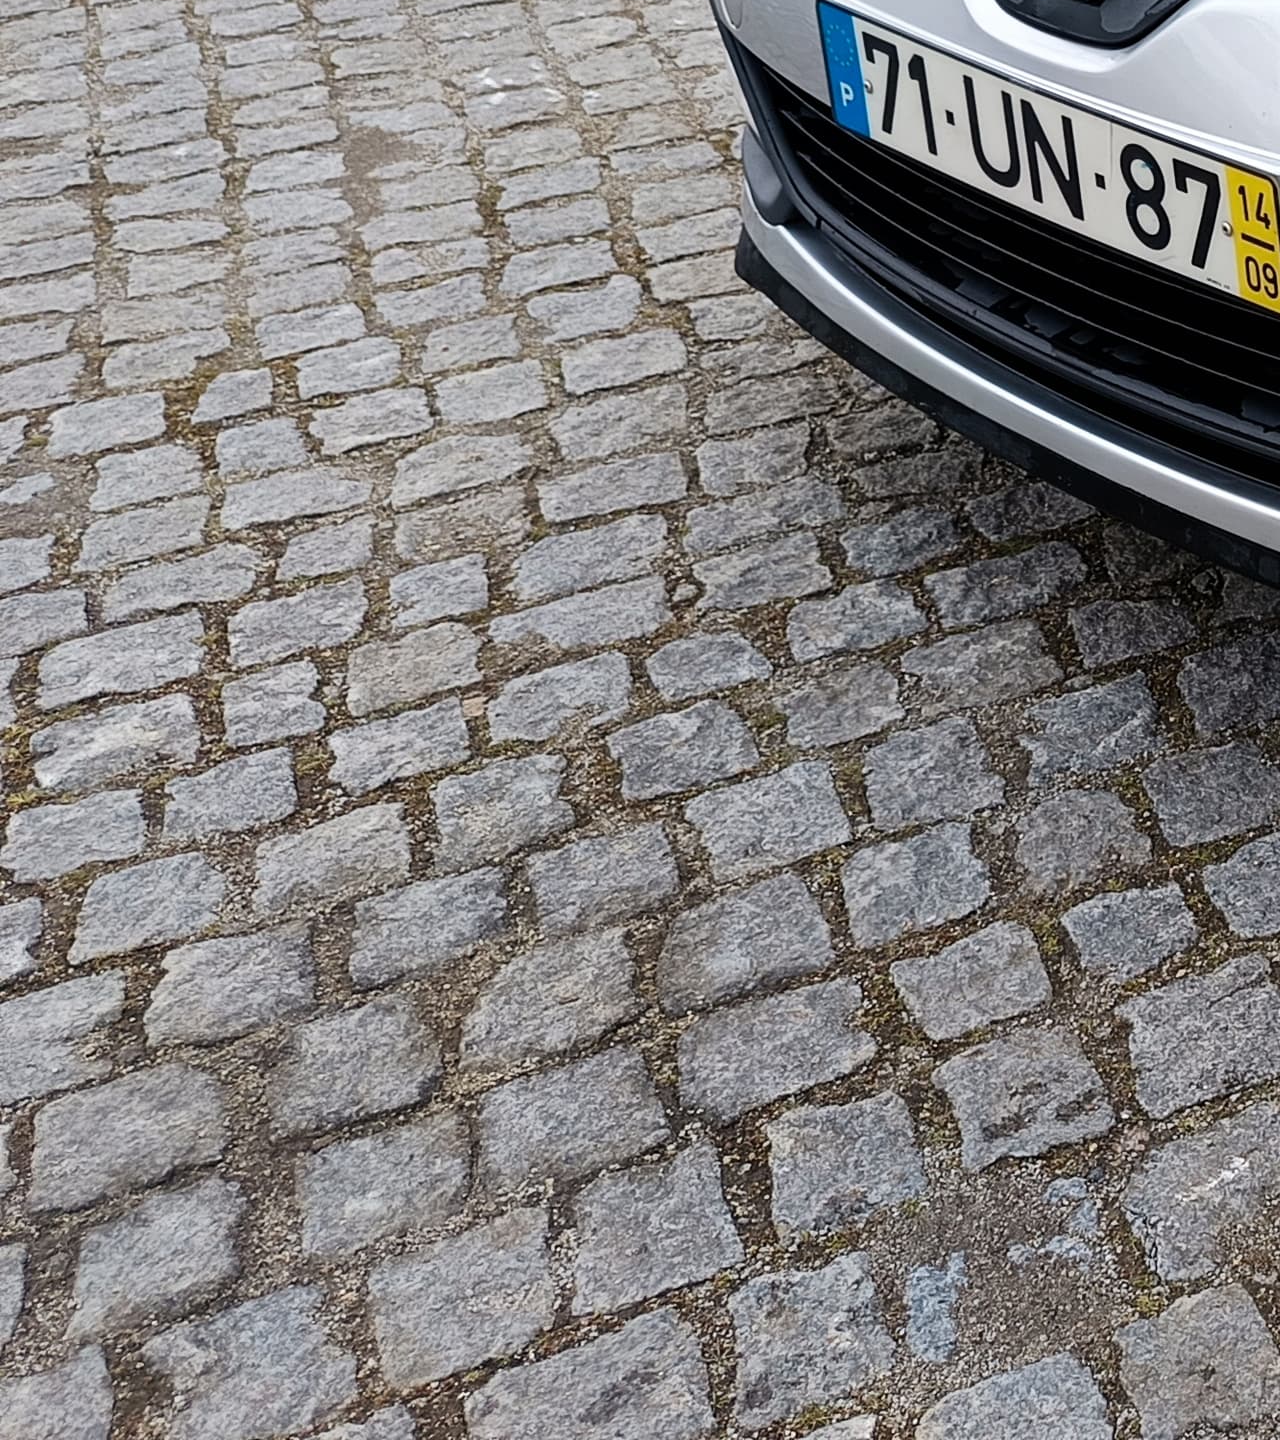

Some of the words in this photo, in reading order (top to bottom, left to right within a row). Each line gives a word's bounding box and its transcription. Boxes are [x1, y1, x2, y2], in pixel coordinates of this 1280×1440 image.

[839, 80, 855, 107] P
[1237, 184, 1272, 230] 14
[1244, 255, 1279, 300] 09
